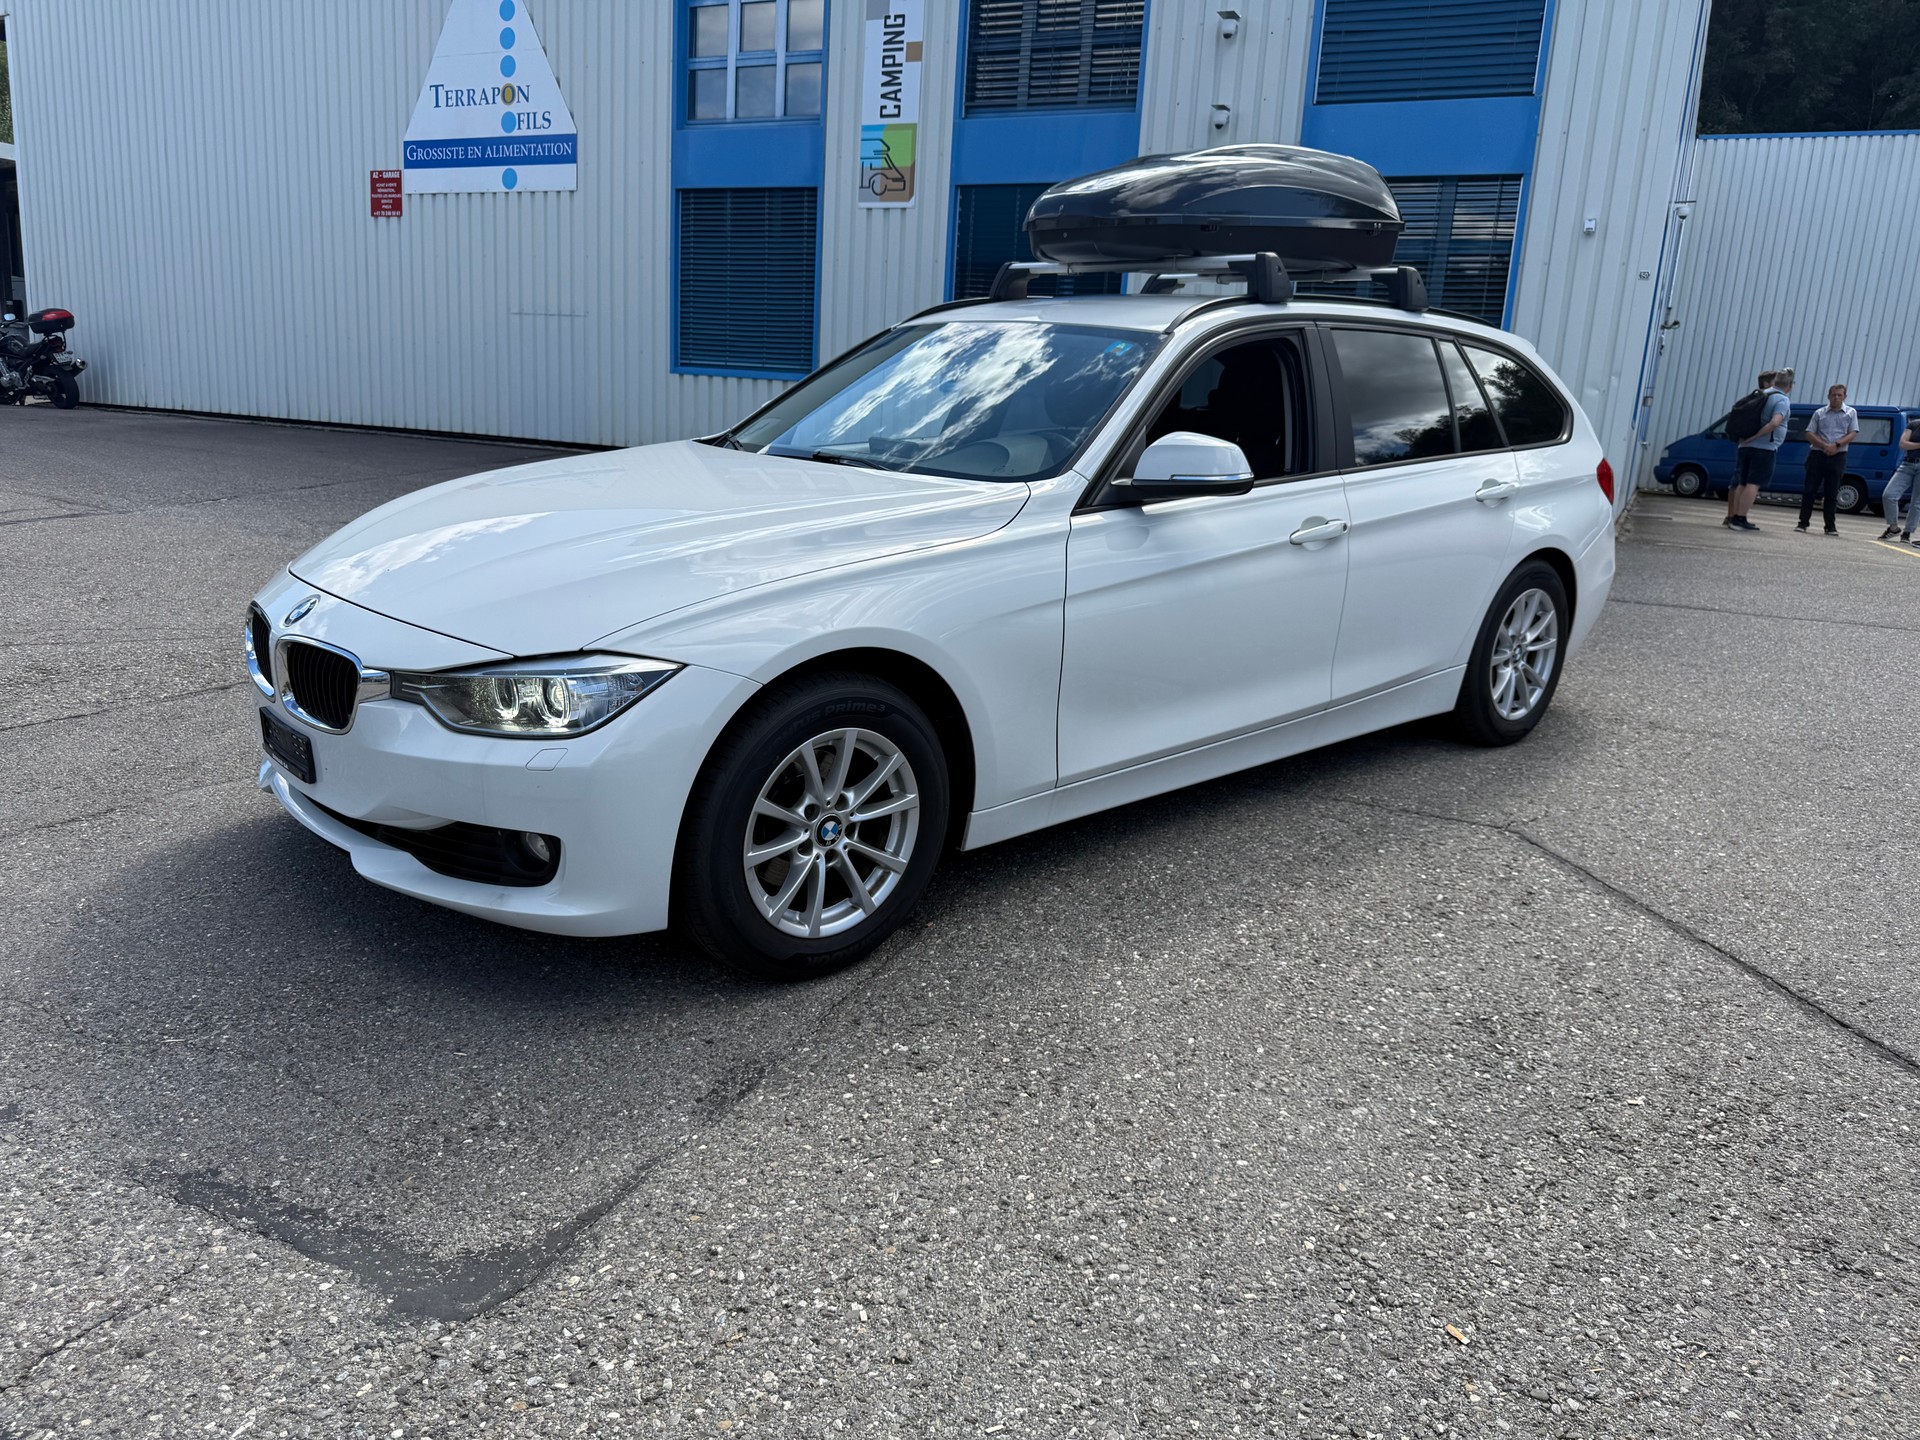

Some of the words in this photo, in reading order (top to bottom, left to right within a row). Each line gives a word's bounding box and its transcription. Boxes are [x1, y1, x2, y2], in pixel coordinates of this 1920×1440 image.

[879, 14, 905, 119] CAMPING
[429, 83, 530, 108] TERRAPON
[516, 111, 552, 130] FILS
[406, 144, 465, 161] GROSSISTE
[467, 145, 482, 159] EN
[485, 142, 573, 158] ALIMENTATION
